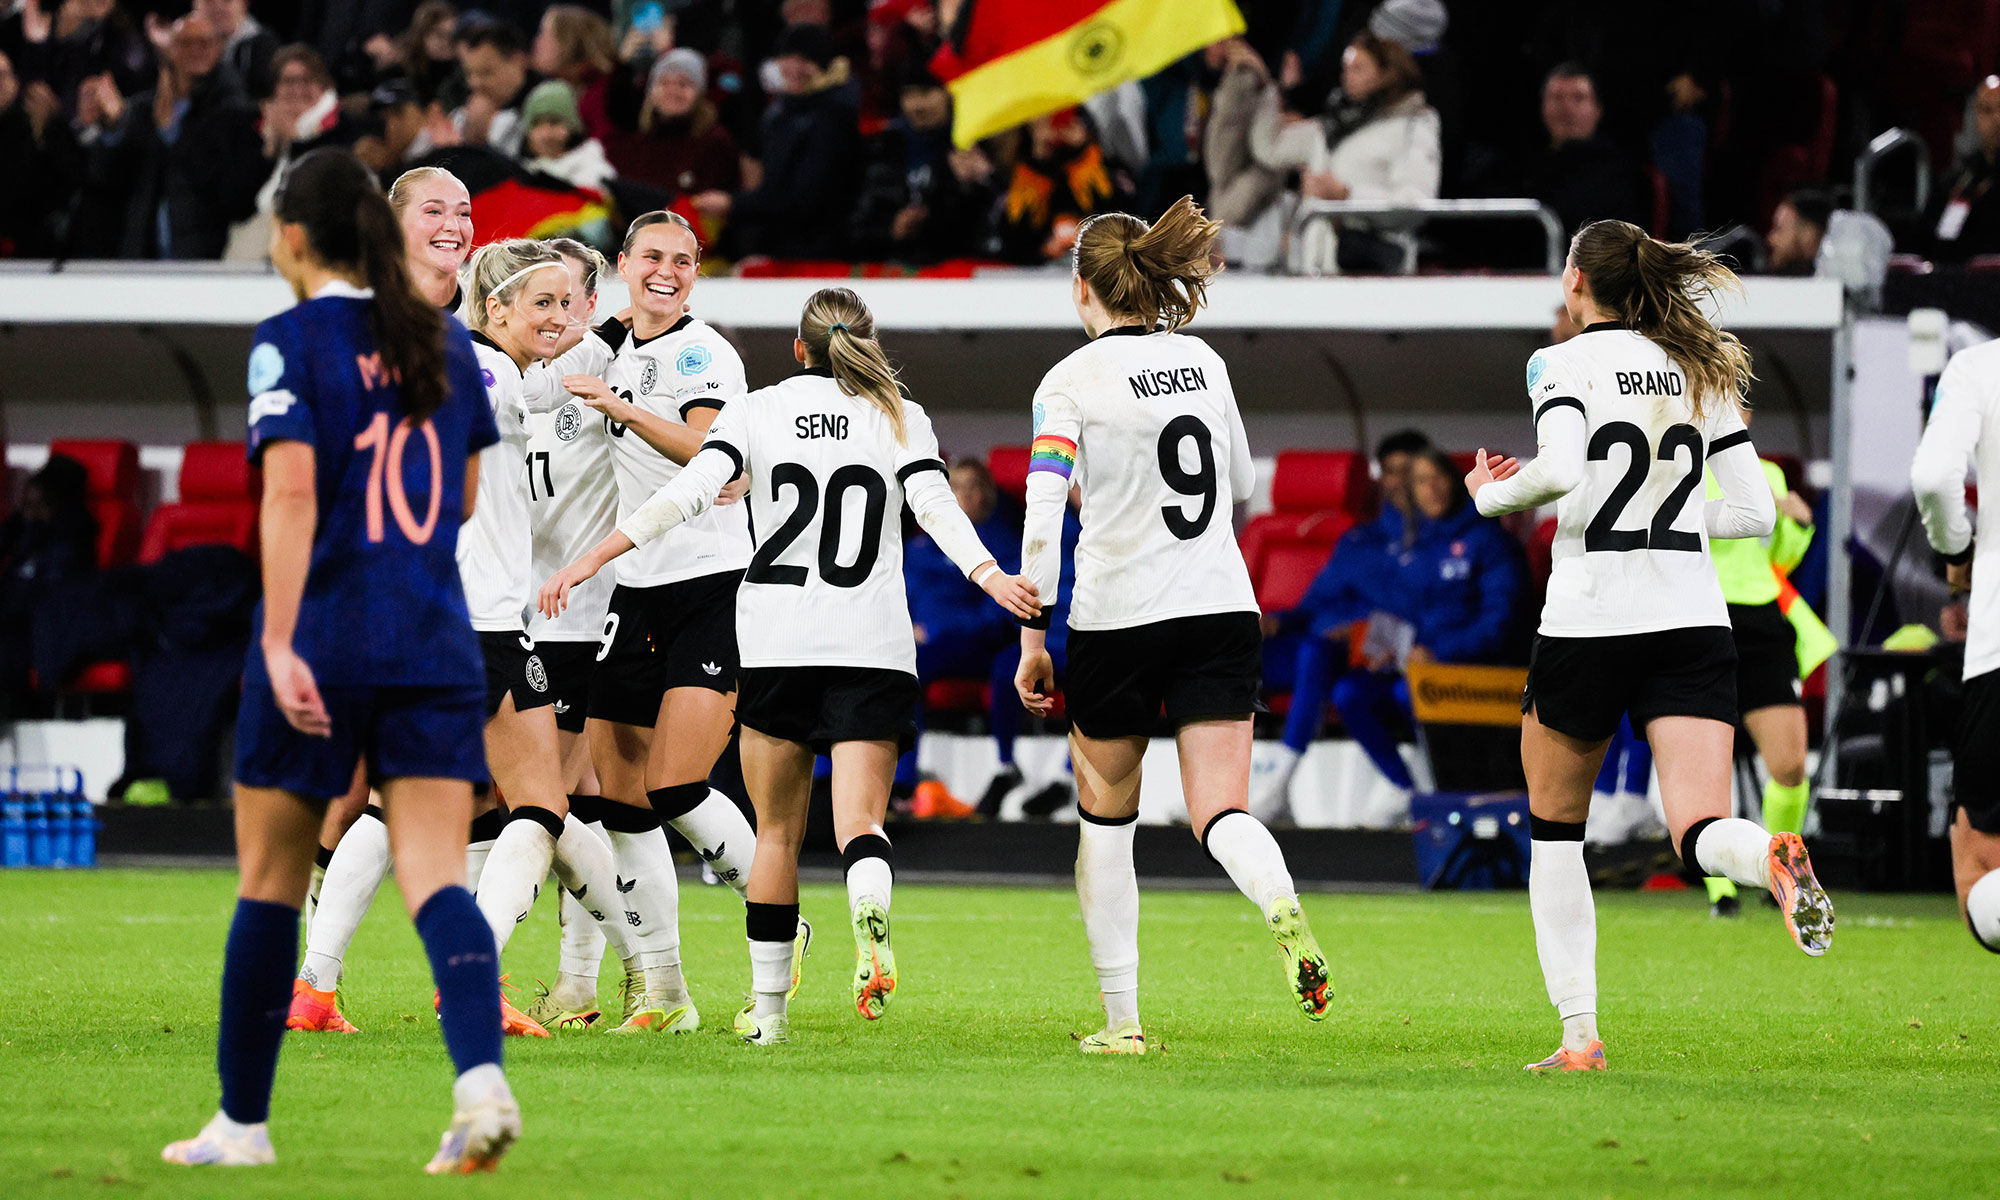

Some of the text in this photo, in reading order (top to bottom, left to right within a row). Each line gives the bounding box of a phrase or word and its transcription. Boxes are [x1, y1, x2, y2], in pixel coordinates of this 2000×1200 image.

[1129, 367, 1208, 399] NÜSKEN
[1615, 371, 1682, 396] BRAND
[354, 411, 443, 546] 10
[525, 451, 555, 502] 17
[1157, 414, 1217, 541] 9
[1584, 421, 1704, 553] 22
[744, 462, 888, 588] 20
[1418, 679, 1523, 705] Continenta
